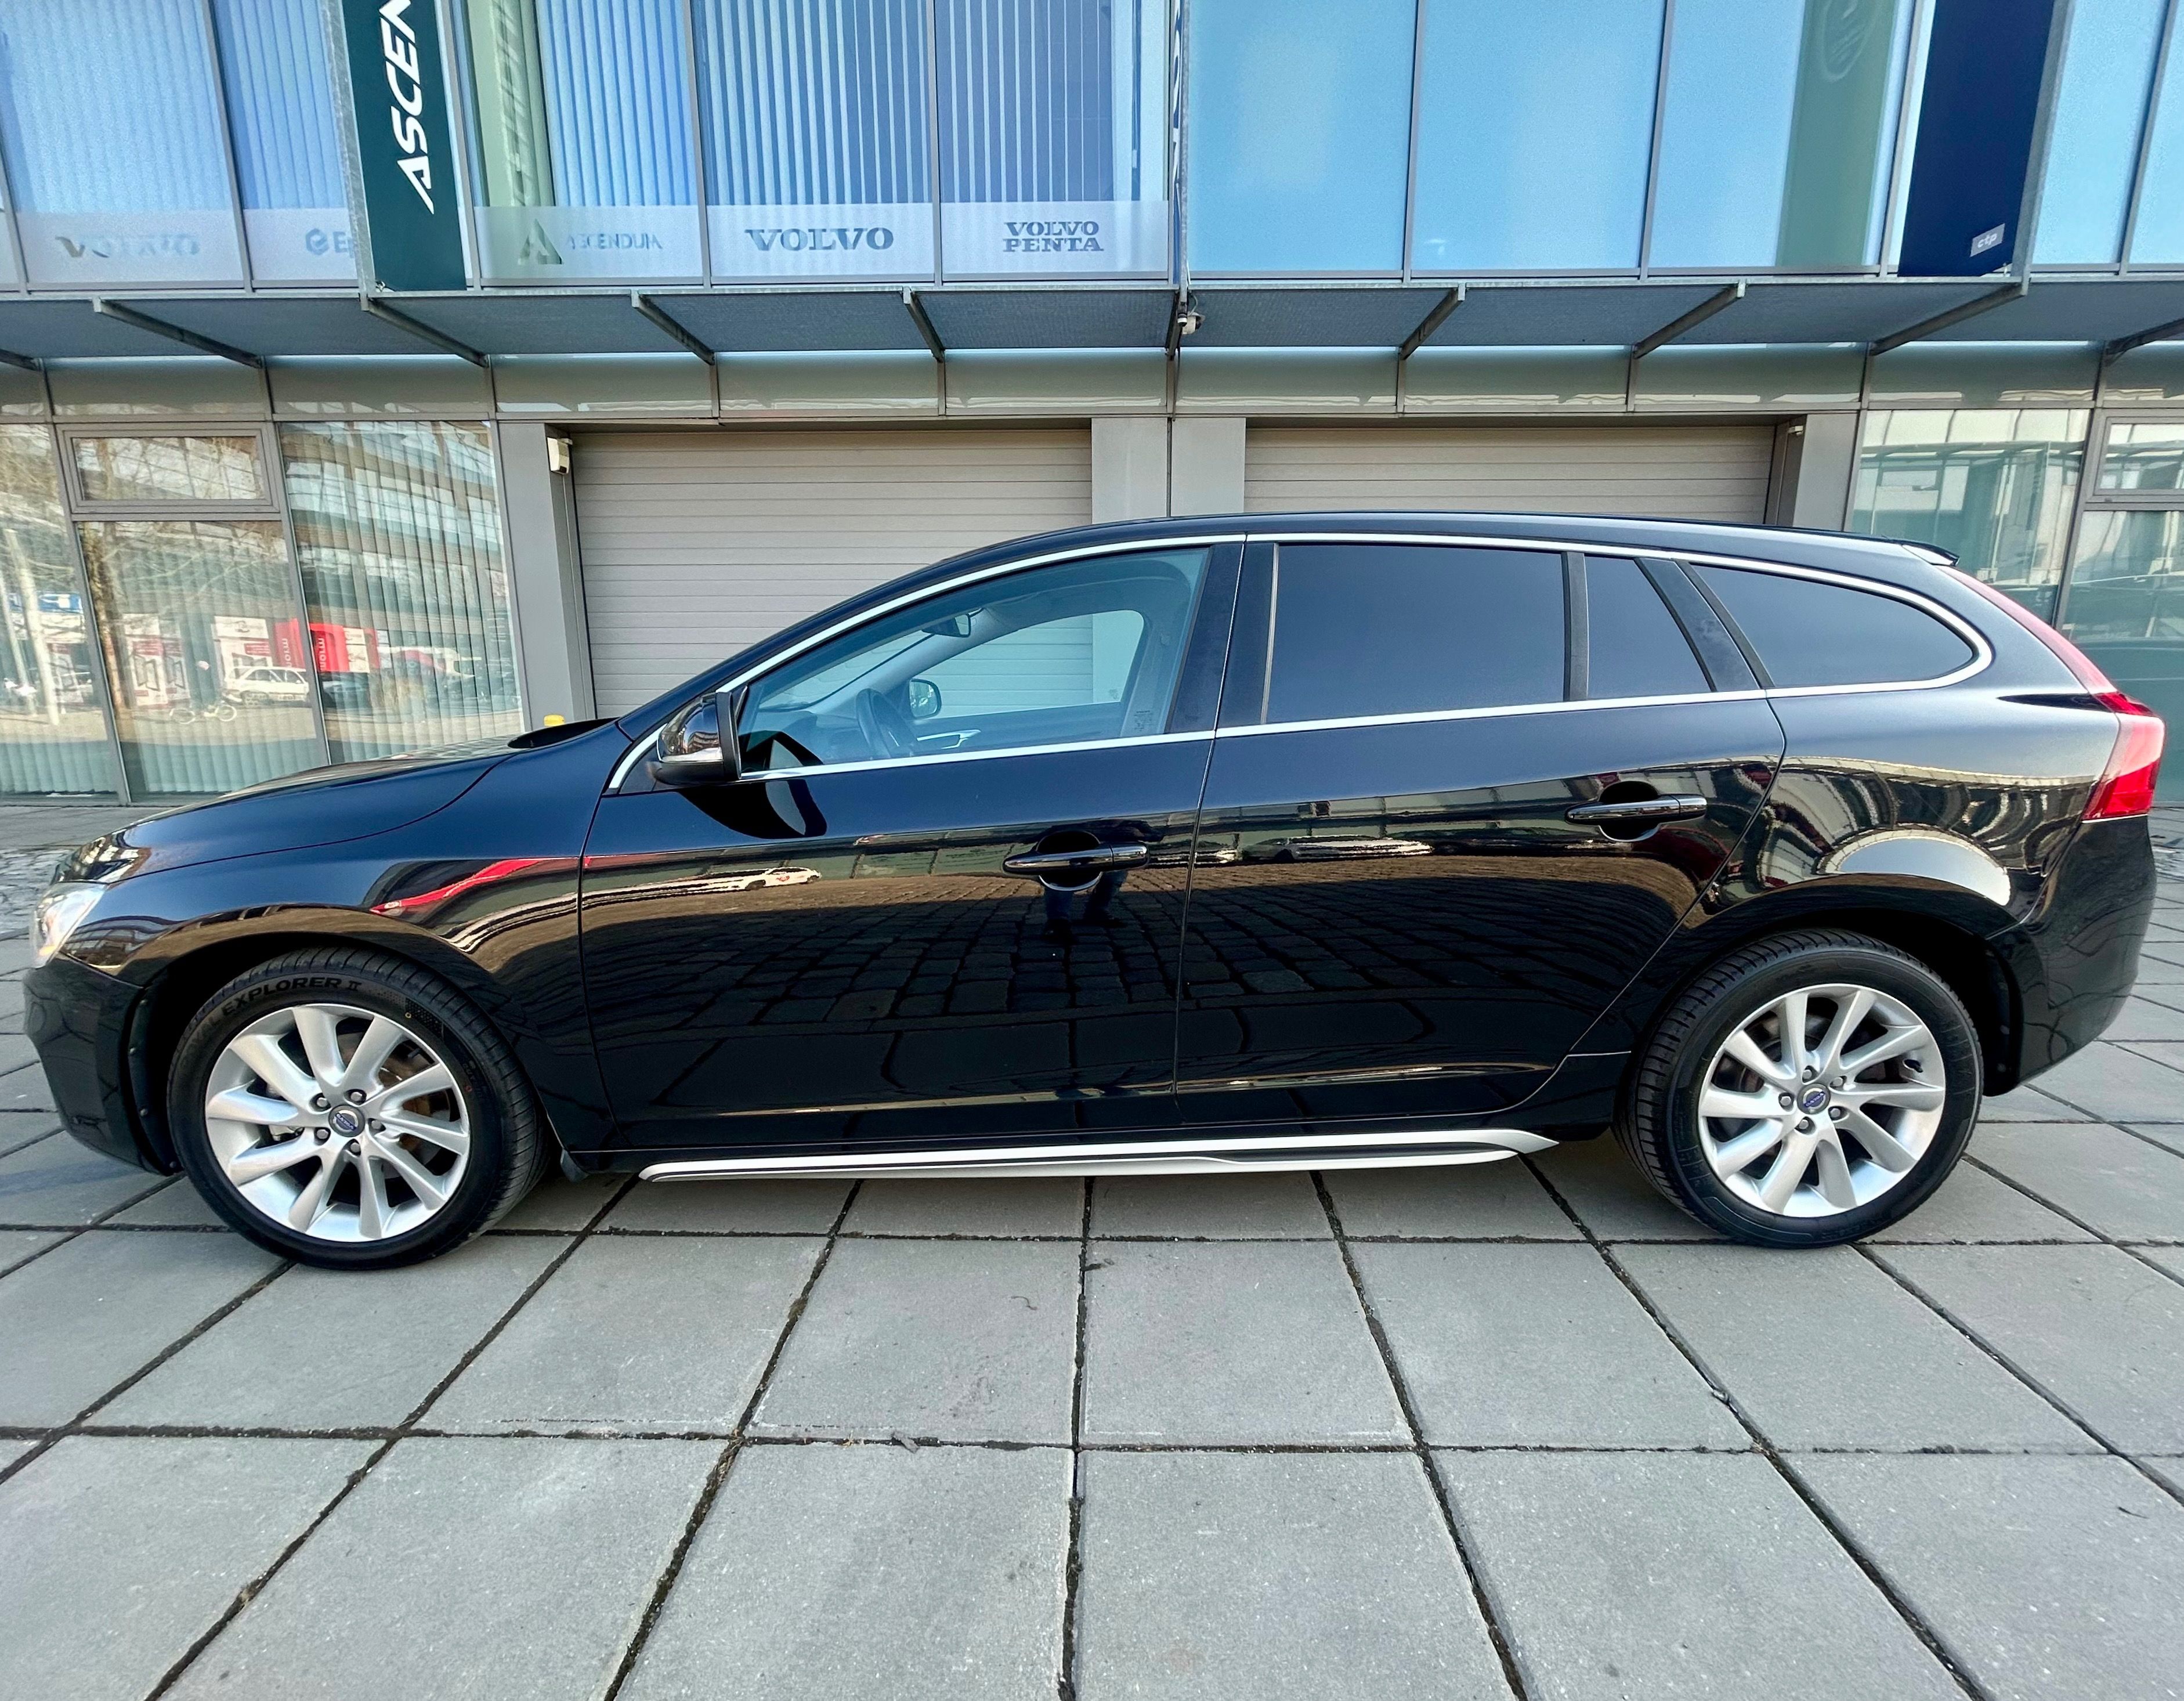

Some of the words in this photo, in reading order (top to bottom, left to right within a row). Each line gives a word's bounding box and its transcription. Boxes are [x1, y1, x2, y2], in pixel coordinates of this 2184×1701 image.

[1004, 221, 1100, 236] VOLVO
[744, 227, 894, 251] VOLVO
[1003, 237, 1105, 252] PENTA
[220, 977, 342, 1016] EXPLORER
[348, 980, 362, 991] II
